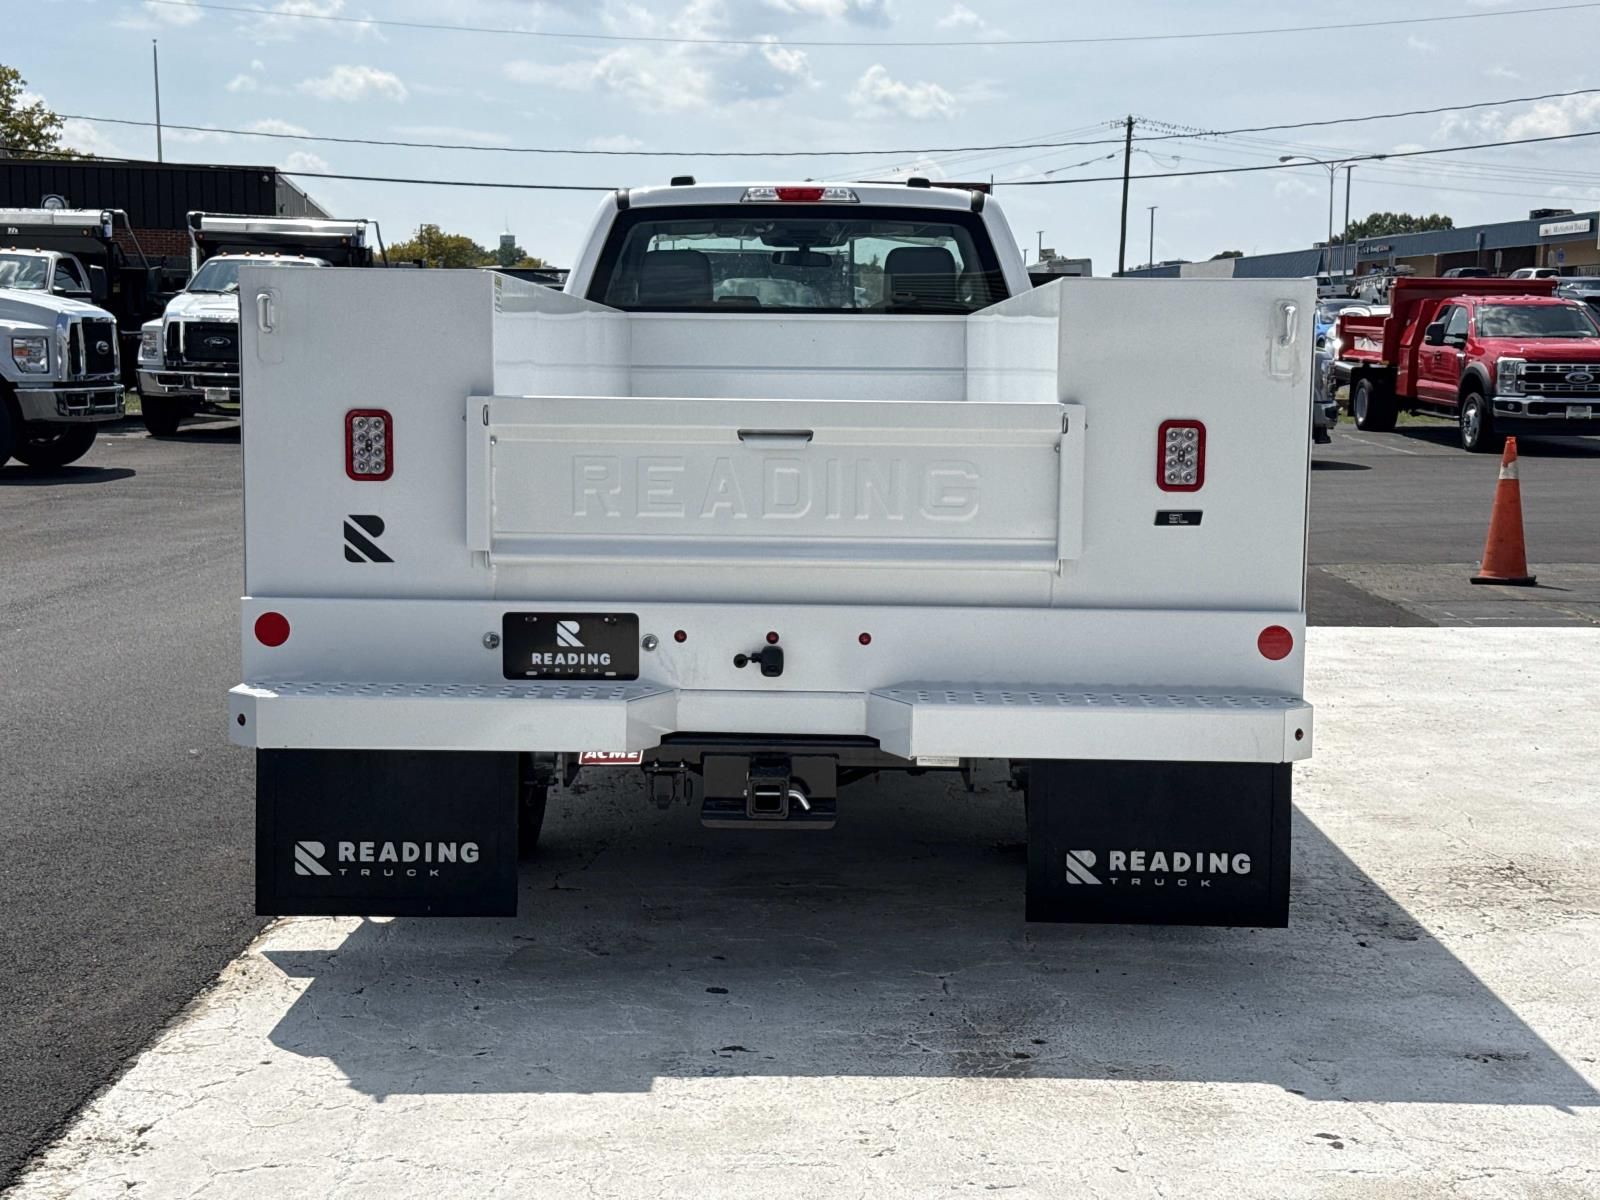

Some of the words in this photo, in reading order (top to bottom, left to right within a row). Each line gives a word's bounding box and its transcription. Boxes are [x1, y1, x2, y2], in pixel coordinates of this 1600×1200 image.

[572, 455, 980, 522] READING
[531, 652, 611, 666] READING
[338, 841, 479, 863] READING
[1109, 850, 1251, 875] READING
[338, 868, 440, 877] TRUCK
[1109, 877, 1212, 887] TRUCK
